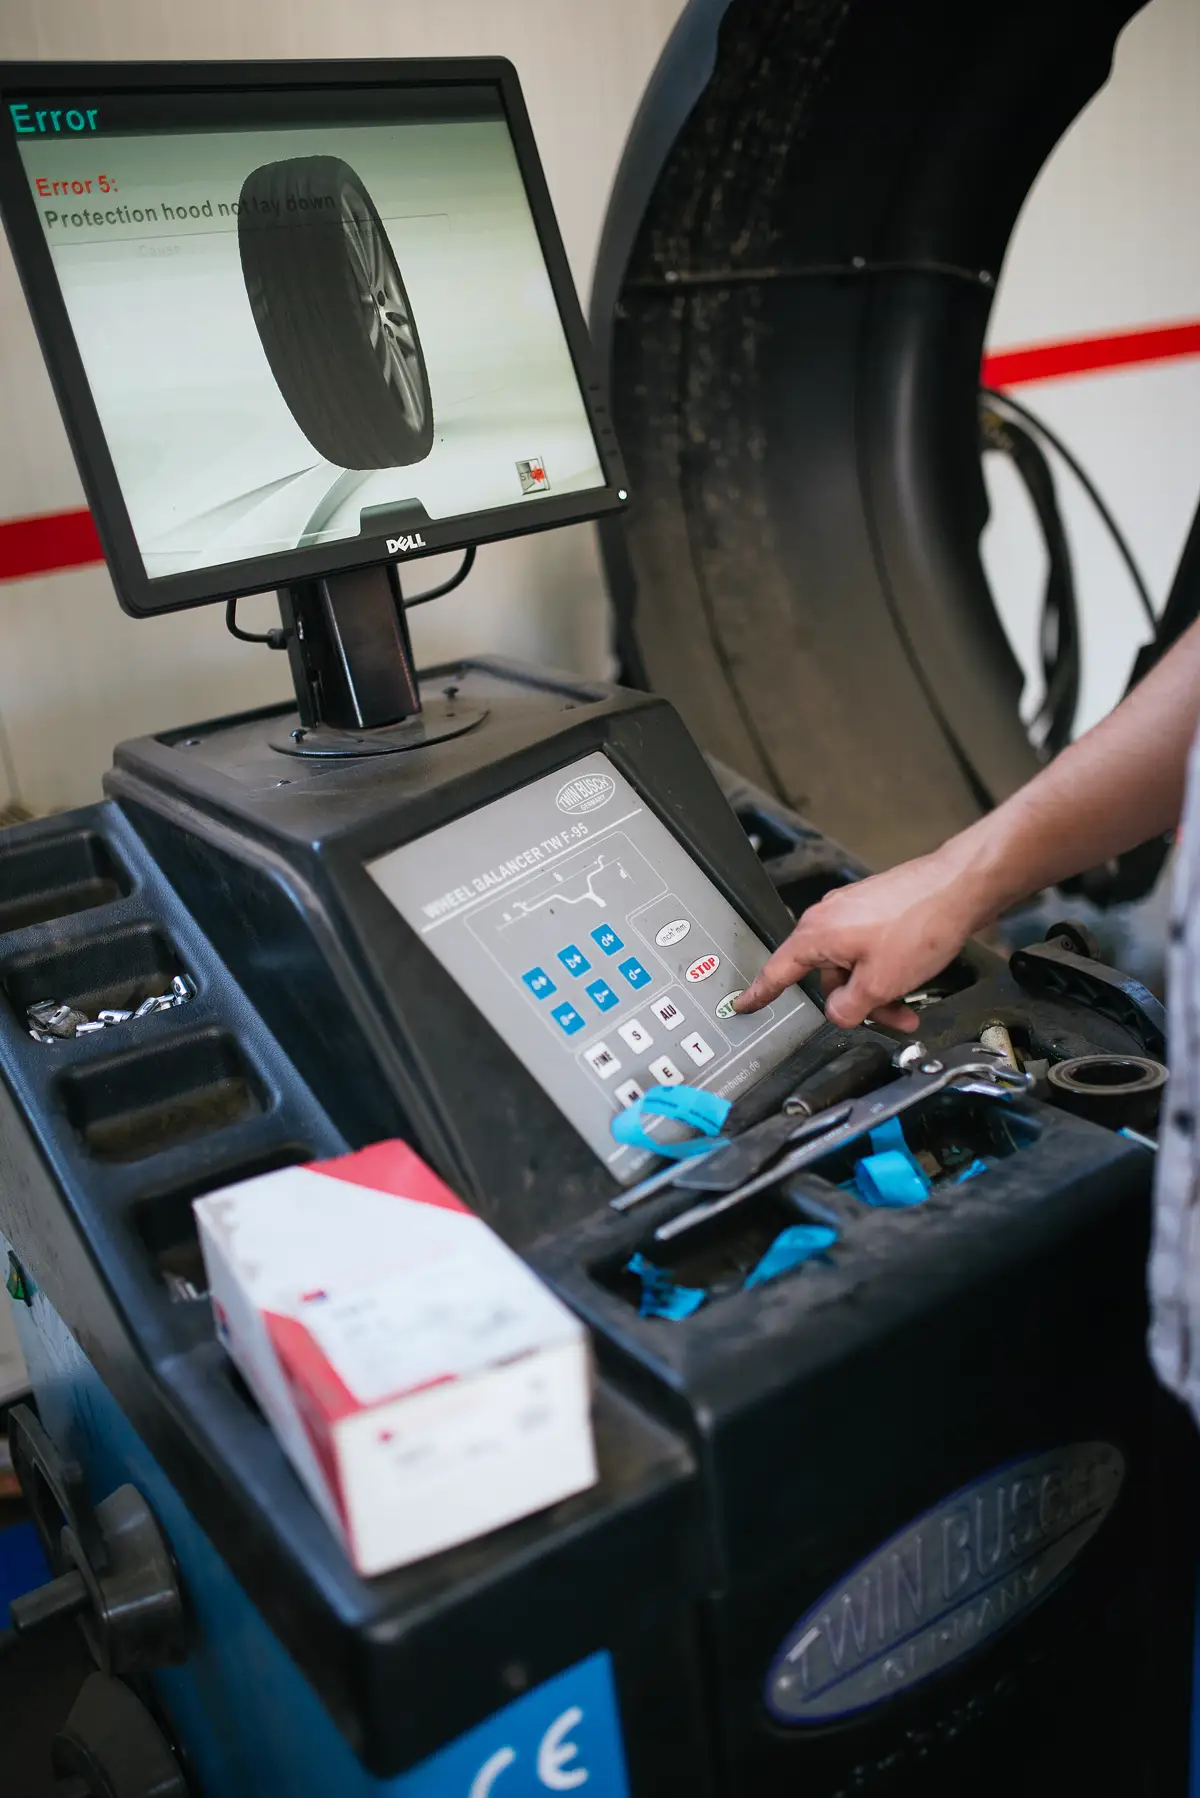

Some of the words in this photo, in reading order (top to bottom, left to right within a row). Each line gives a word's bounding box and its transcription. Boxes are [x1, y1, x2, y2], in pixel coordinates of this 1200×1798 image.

[9, 103, 98, 133] Error
[35, 176, 92, 197] Error
[97, 174, 118, 194] 5:
[45, 204, 158, 229] Protection
[161, 199, 213, 221] hood
[218, 198, 250, 217] not
[252, 196, 279, 218] lay
[286, 194, 336, 213] down
[385, 533, 426, 554] DELL
[559, 785, 583, 808] TWIN
[574, 776, 609, 798] BUSCH
[421, 884, 475, 919] WHEEL
[472, 847, 544, 892] BALANCER
[540, 836, 563, 853] TW
[560, 822, 588, 844] F-95
[690, 957, 715, 979] STOP
[660, 1004, 677, 1021] ALU
[631, 1030, 642, 1041] S
[692, 1042, 703, 1053] T
[662, 1066, 673, 1078] E
[786, 1535, 923, 1687] TWIN
